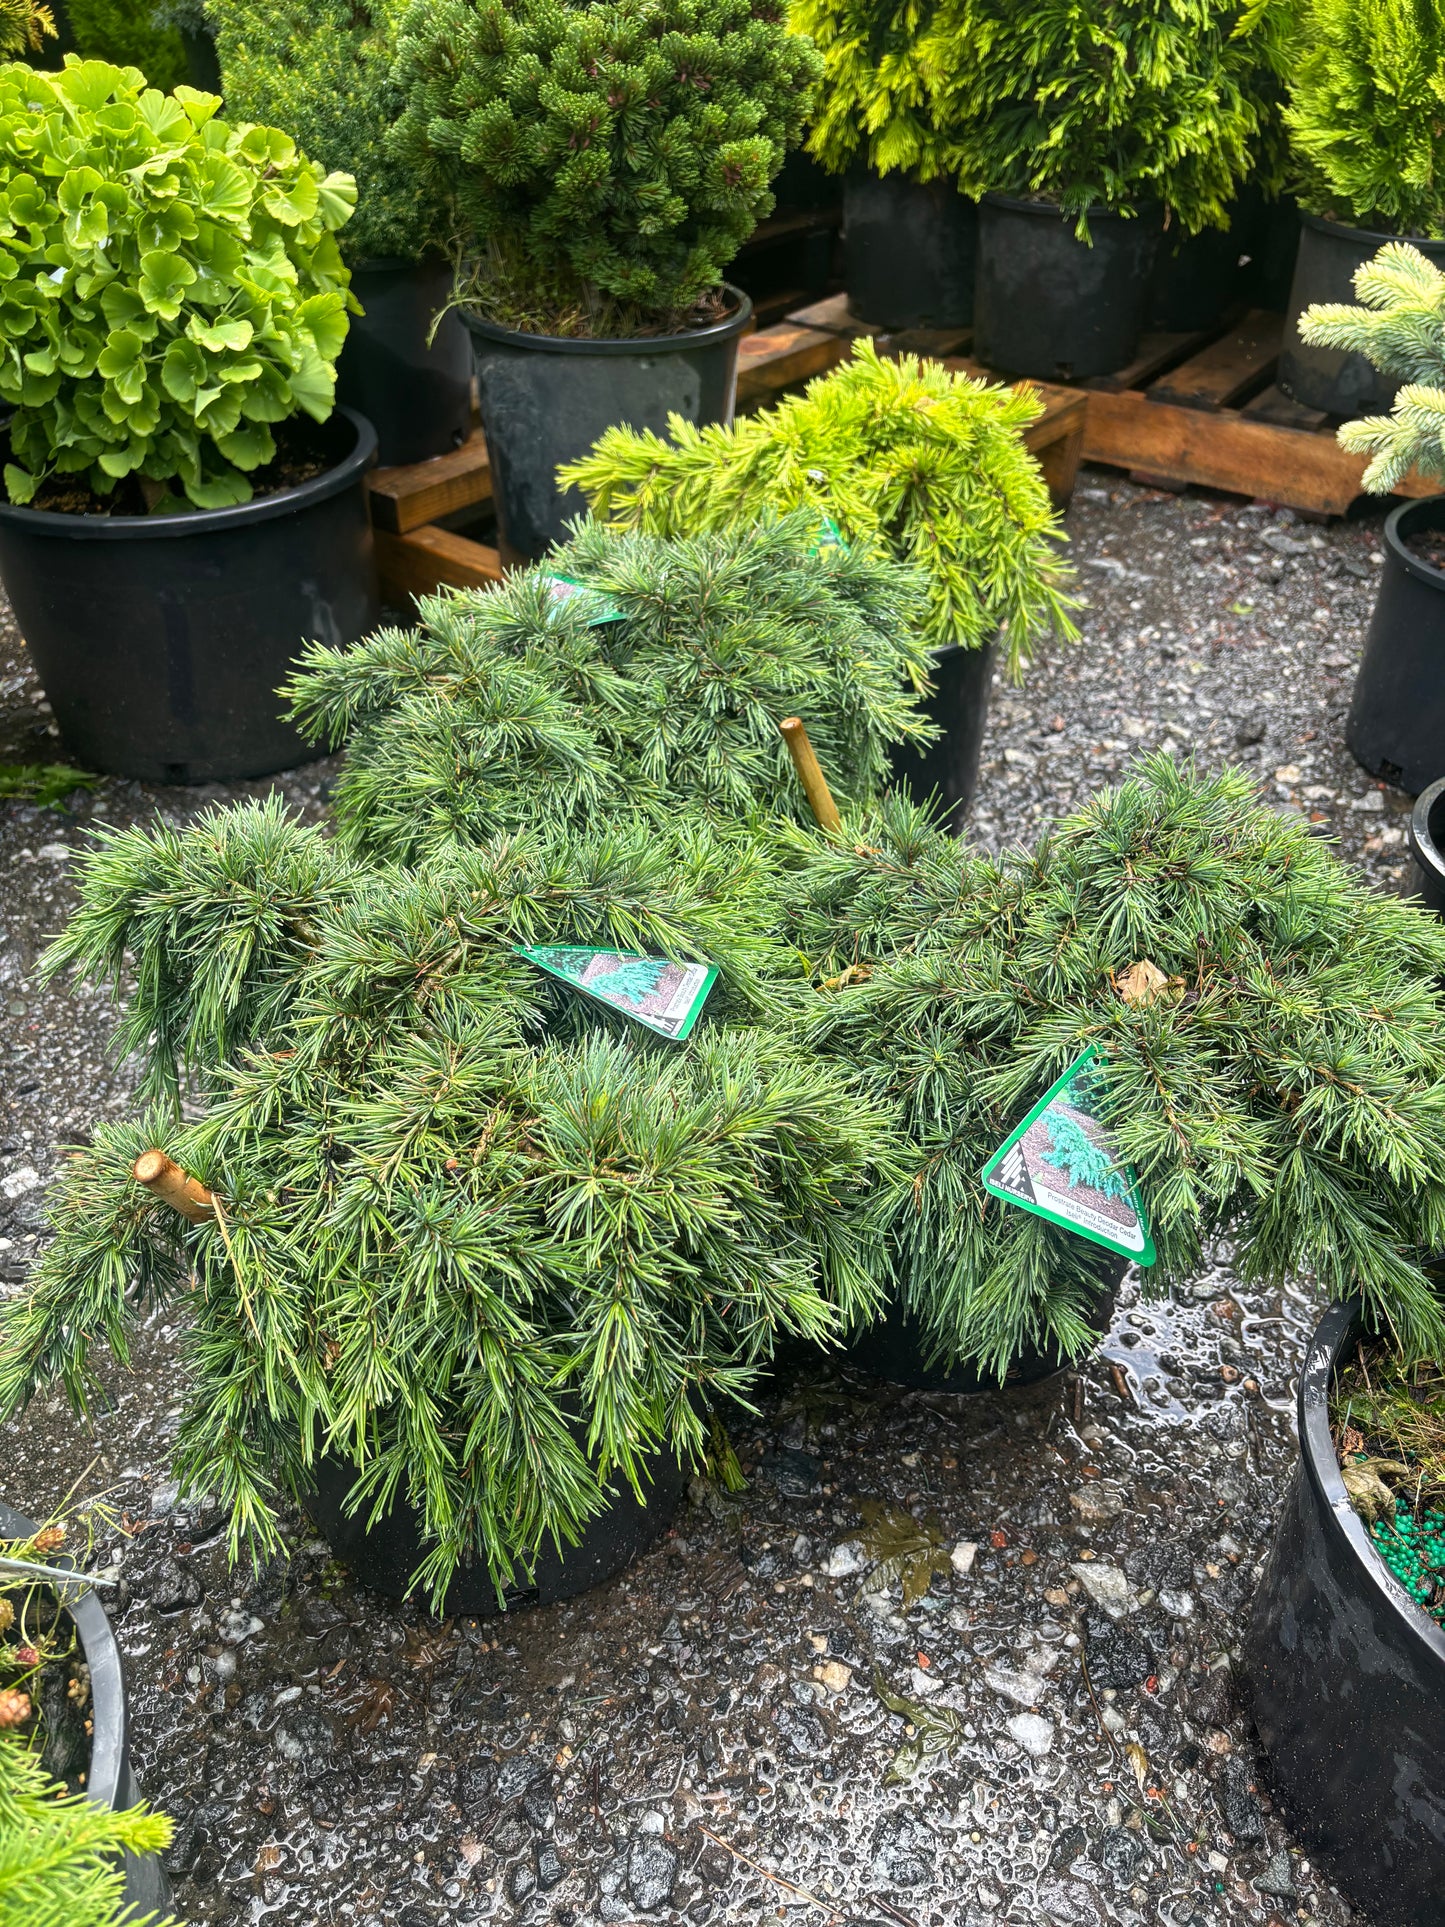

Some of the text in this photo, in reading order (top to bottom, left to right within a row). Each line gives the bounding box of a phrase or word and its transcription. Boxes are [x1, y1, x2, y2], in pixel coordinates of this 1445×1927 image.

[1047, 1191, 1137, 1240] Prostrate Beauty Deodar Cedar
[1083, 1217, 1118, 1239] Introduction
